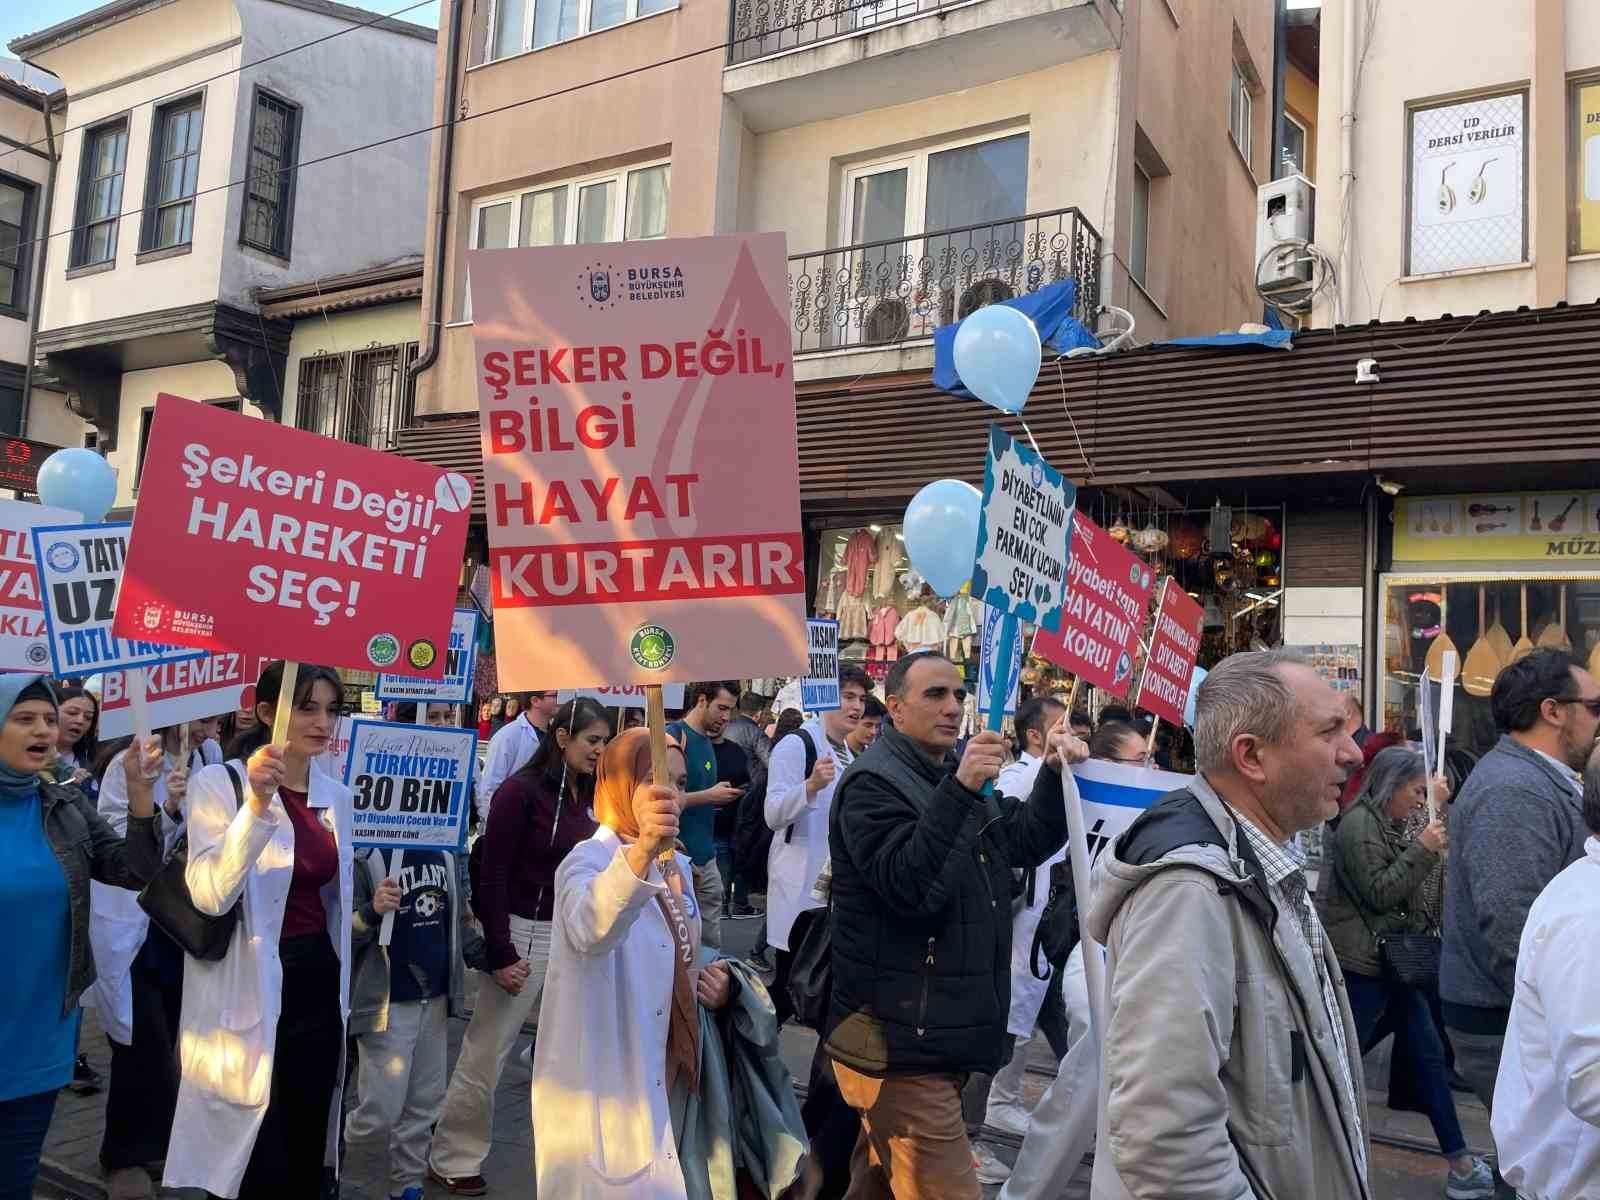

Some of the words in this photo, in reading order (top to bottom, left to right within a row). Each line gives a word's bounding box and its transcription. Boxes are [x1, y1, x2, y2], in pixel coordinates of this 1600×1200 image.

[1428, 131, 1463, 149] DERSİ
[1466, 124, 1515, 142] VERİLİR
[1463, 117, 1480, 129] UD
[627, 266, 682, 280] BURSA
[630, 290, 685, 300] BELEDİYESİ
[483, 343, 626, 400] ŞEKER
[640, 328, 785, 380] DEĞİL,
[489, 391, 636, 454] BİLGİ
[182, 443, 326, 504] Şekeri
[332, 479, 442, 536] Değil,
[494, 474, 699, 527] HAYAT
[1002, 469, 1065, 529] DİYABETLİNİN
[187, 496, 428, 579] HAREKETİ
[1013, 507, 1027, 535] EN
[1029, 516, 1048, 547] ÇOK
[1545, 537, 1600, 555] MÜZ
[499, 542, 794, 599] KURTARIR
[995, 526, 1037, 569] PARMAK
[1037, 555, 1062, 583] UCUNU
[246, 564, 361, 626] SEÇ!
[1009, 567, 1034, 599] SEV
[174, 610, 214, 624] BURSA
[1062, 586, 1130, 647] HAYATINI
[1158, 613, 1190, 649] FARKINDA
[811, 626, 836, 651] YAŞAM
[1063, 625, 1112, 672] KORU!
[104, 652, 239, 701] BKLEMEZ
[365, 750, 459, 779] TÜRKİYEDE
[354, 775, 394, 812] 30
